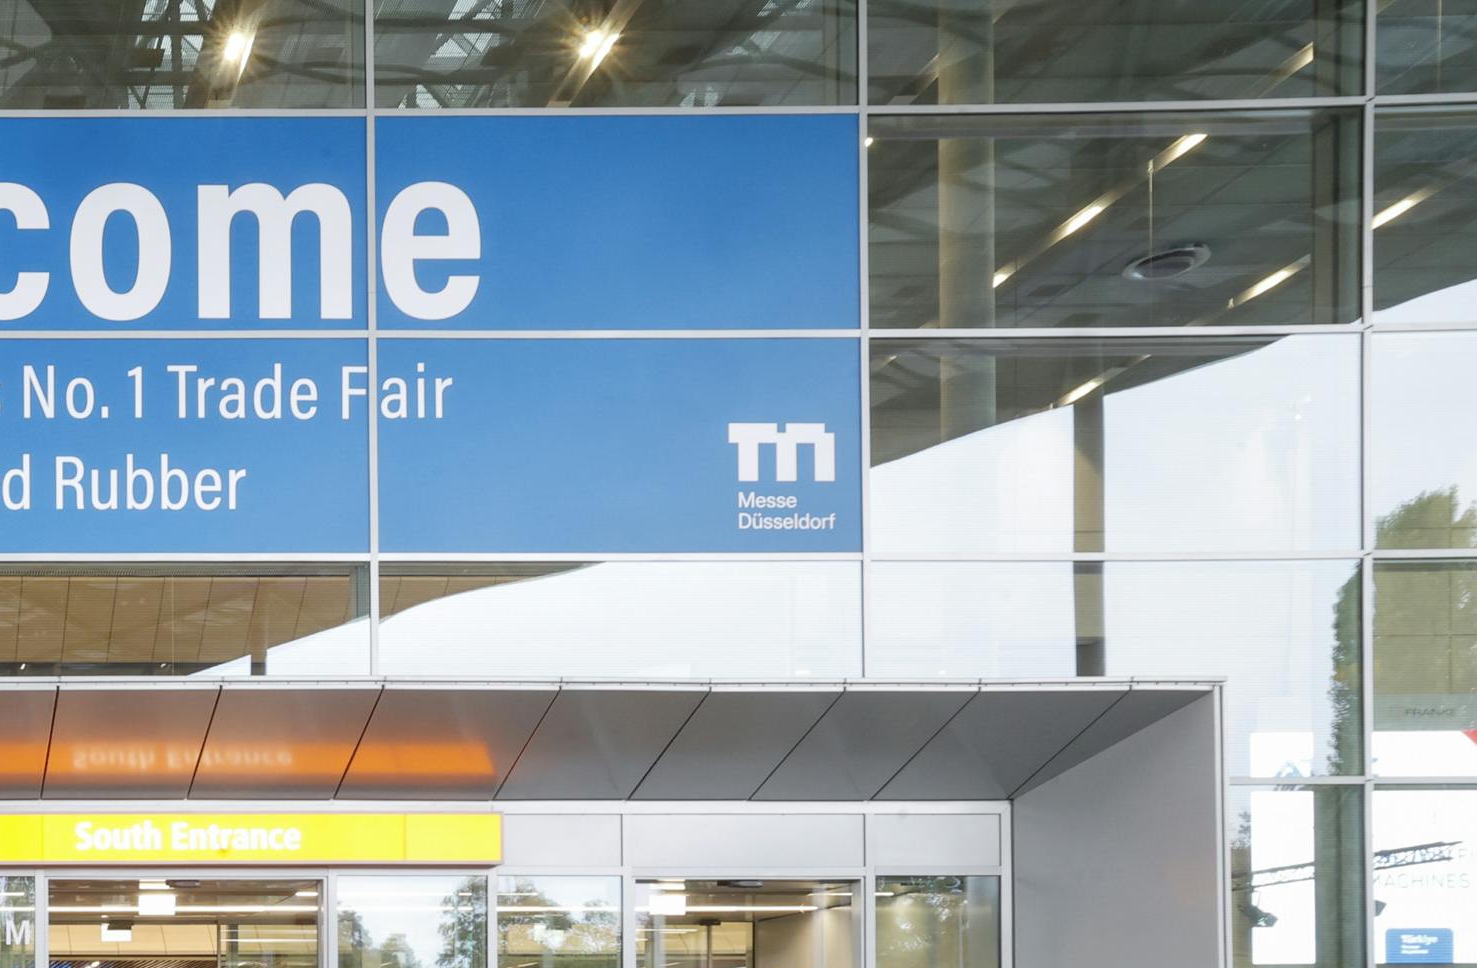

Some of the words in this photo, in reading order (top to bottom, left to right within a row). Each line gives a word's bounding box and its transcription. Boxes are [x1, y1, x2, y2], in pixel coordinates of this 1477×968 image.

[167, 363, 318, 420] Trade
[342, 362, 453, 420] Fair
[55, 453, 247, 511] Rubber
[738, 491, 798, 508] Messe
[738, 512, 837, 530] Düsseldorf
[75, 820, 163, 850] South
[171, 821, 302, 850] Entrance
[6, 920, 31, 945] M
